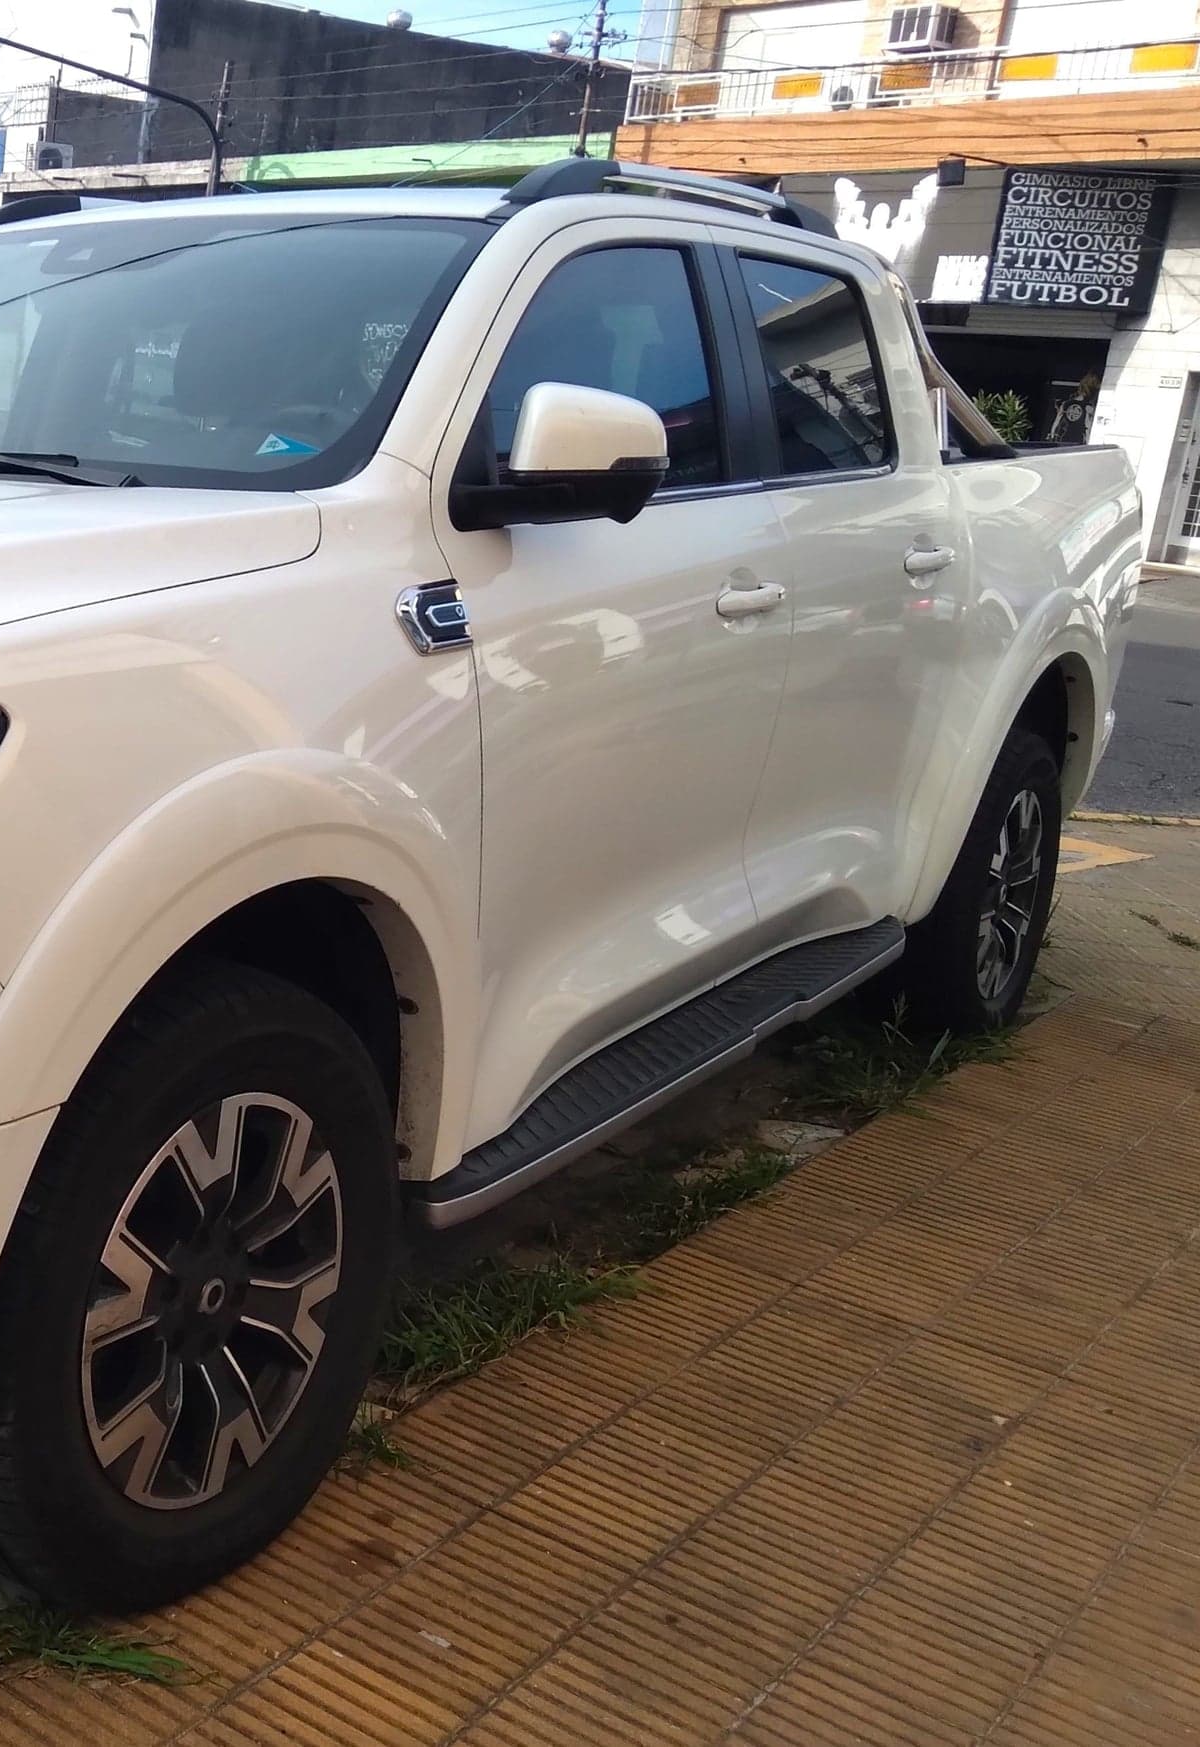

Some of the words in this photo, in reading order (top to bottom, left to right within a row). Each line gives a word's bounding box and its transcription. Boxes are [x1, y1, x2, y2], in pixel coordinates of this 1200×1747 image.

[1011, 172, 1100, 188] GIMNASIO
[1106, 177, 1156, 191] LIBRE
[1007, 186, 1152, 210] CIRCUITOS
[1004, 204, 1149, 223] ENTRENAMIENTOS
[1001, 217, 1145, 235] PERSONALIZADOS
[998, 229, 1141, 252] FUNCIONAL
[994, 246, 1139, 274] FITNESS
[992, 267, 1135, 287] ENTRENAMIENTOS
[988, 279, 1129, 307] FUTBOL
